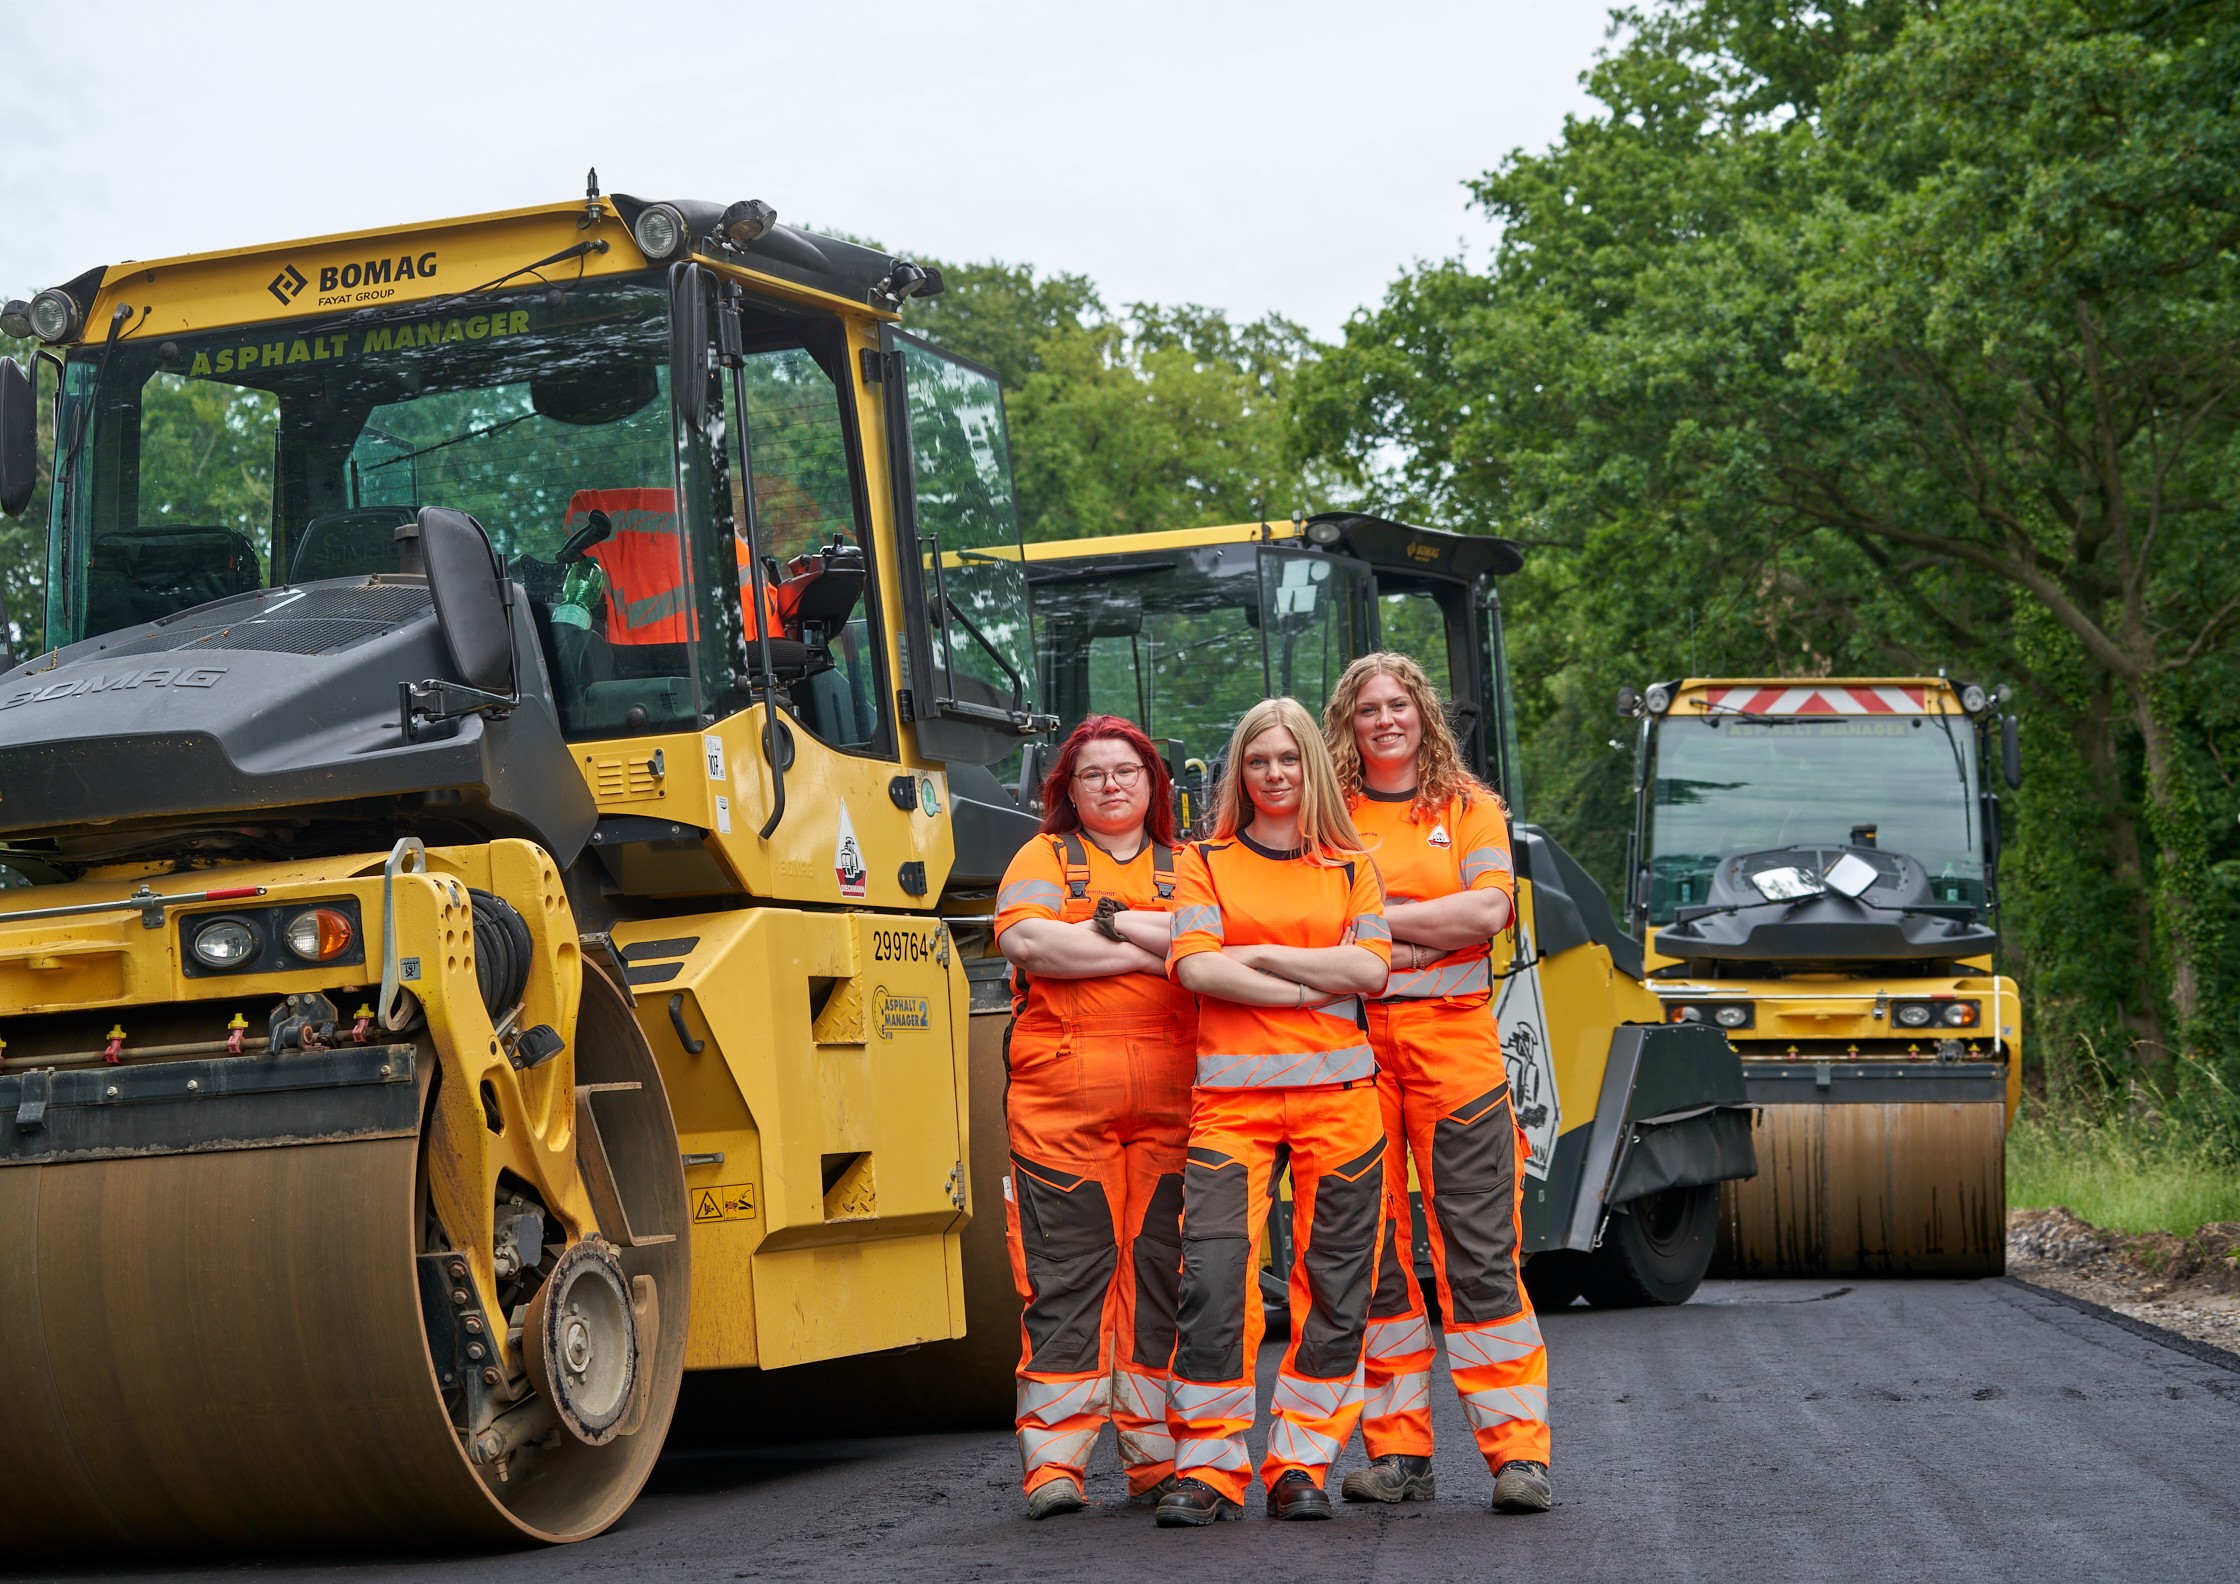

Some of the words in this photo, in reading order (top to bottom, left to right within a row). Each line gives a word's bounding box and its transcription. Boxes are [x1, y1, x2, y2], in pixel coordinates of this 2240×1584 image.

[319, 252, 437, 292] BOMAG
[318, 294, 352, 306] FAYAT
[356, 288, 395, 302] GROUP
[189, 334, 349, 377] ASPHALT
[362, 310, 530, 354] MANAGER
[0, 667, 229, 710] BOMAG
[707, 754, 719, 776] 107
[1085, 889, 1115, 897] annhorst
[873, 931, 928, 962] 299764
[884, 998, 916, 1012] ASPHALT
[919, 1000, 929, 1027] 2
[884, 1013, 920, 1027] MANAGER
